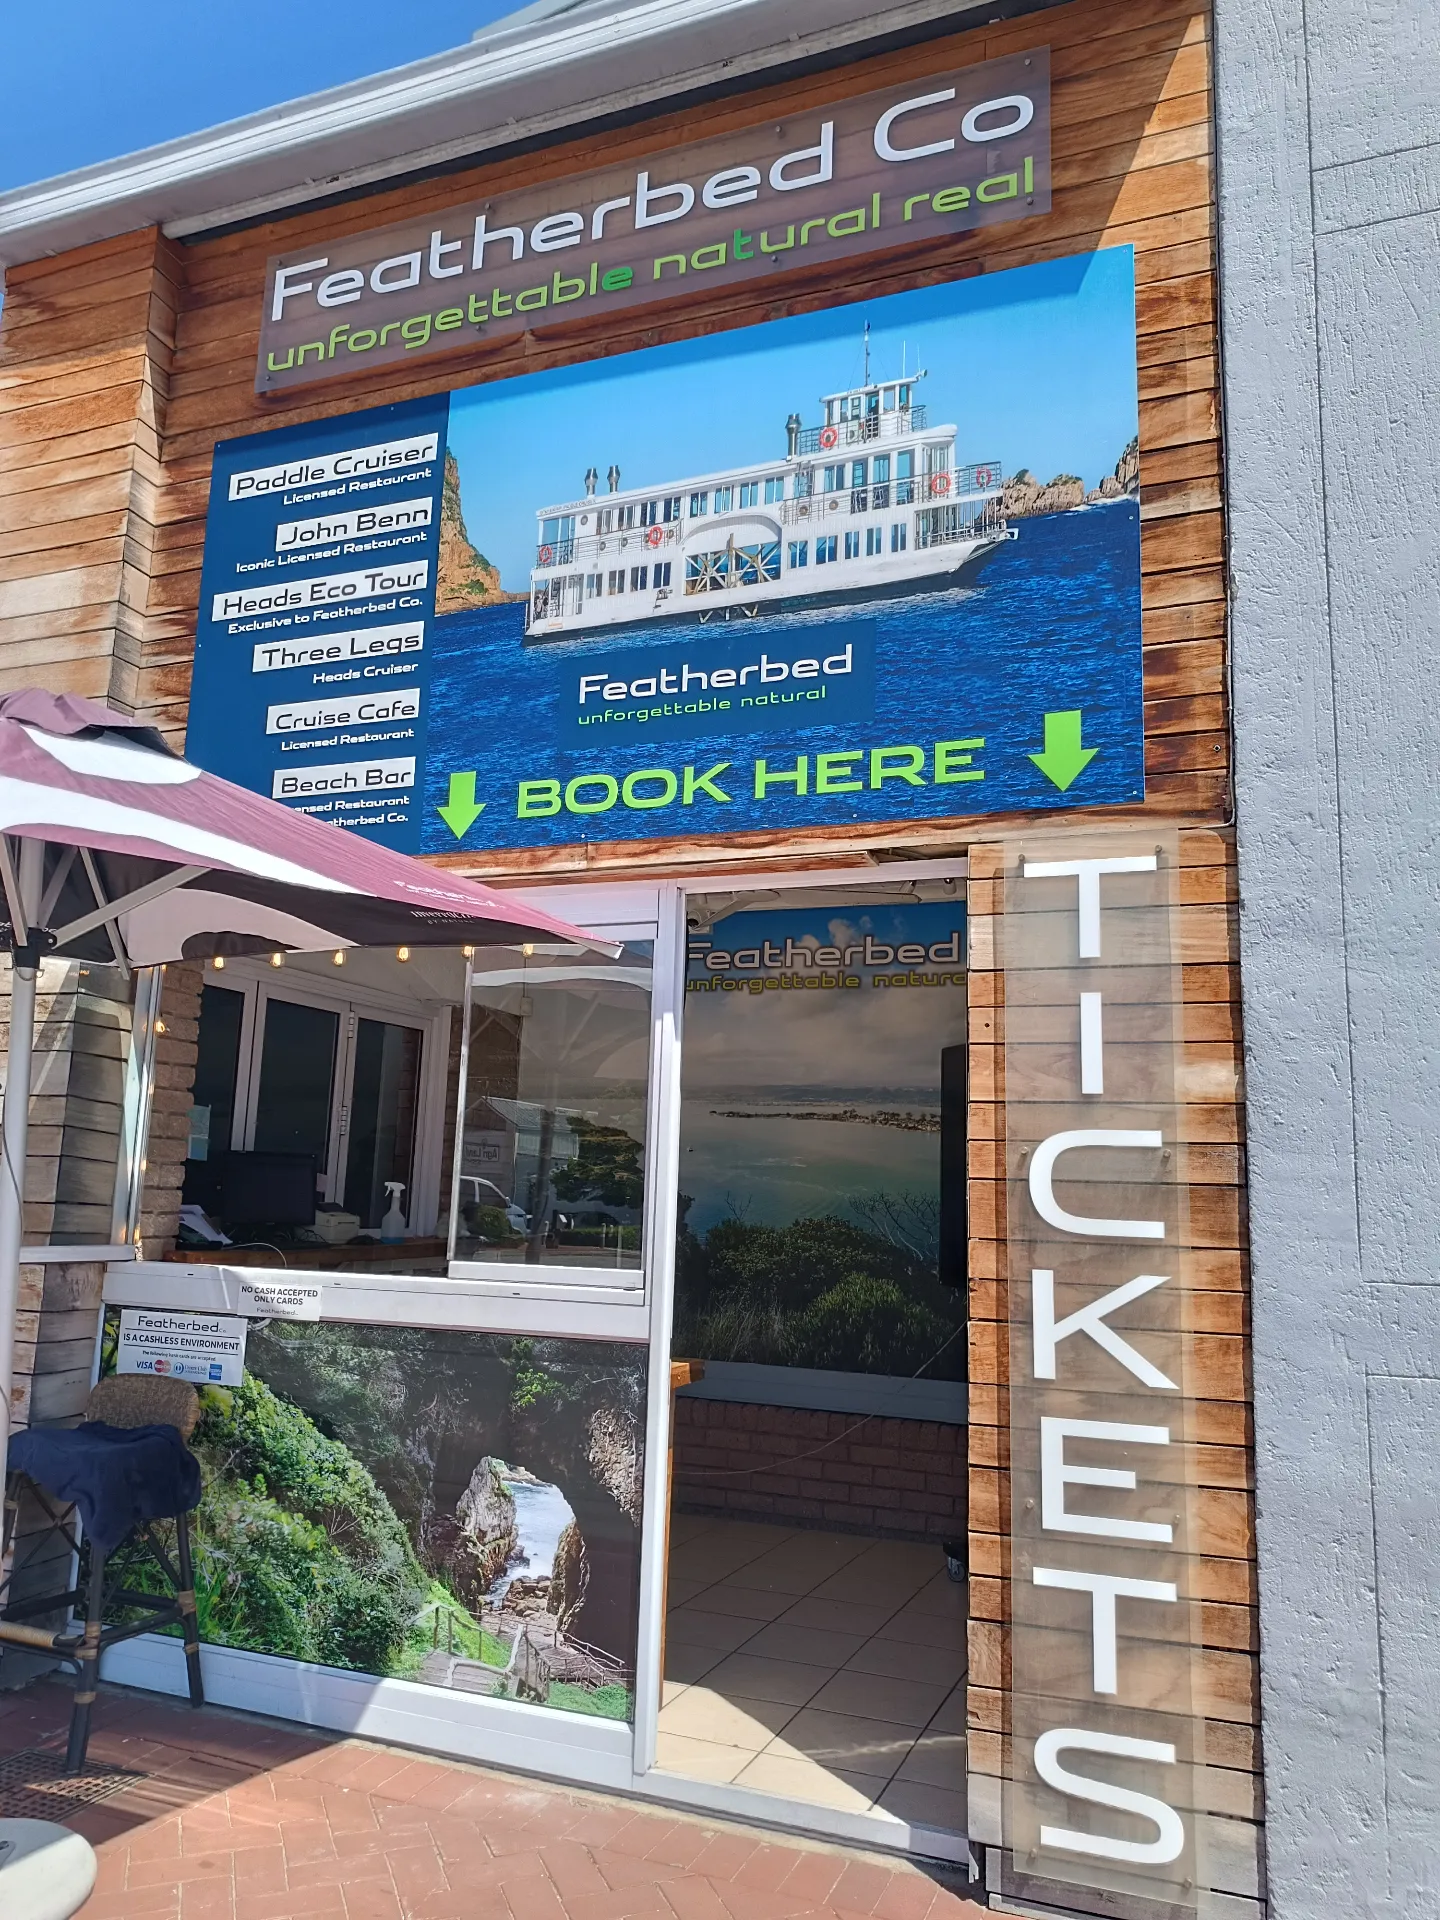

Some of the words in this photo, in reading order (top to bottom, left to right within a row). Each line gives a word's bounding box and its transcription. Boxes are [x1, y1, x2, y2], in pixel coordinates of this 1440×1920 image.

[271, 121, 834, 321] Featherbed
[873, 87, 1034, 162] Co
[267, 261, 633, 371] unforgettable
[653, 192, 880, 280] natural
[904, 157, 1034, 221] real
[236, 466, 325, 495] Paddle
[333, 445, 433, 475] Cruiser
[283, 484, 345, 505] Licensed
[349, 468, 432, 492] Restaurant
[281, 523, 348, 546] John
[357, 509, 428, 532] Benn
[236, 559, 275, 573] Iconic
[278, 547, 340, 566] Licensed
[344, 532, 427, 554] Restaurant
[223, 589, 302, 616] Heads
[310, 582, 357, 601] Eco
[365, 572, 424, 592] Tour
[228, 617, 291, 634] Exclusive
[294, 614, 310, 624] to
[313, 599, 396, 621] Featherbed
[399, 596, 423, 608] Co.
[262, 646, 341, 667] Three
[350, 634, 420, 655] Legs
[313, 670, 360, 683] Heads
[363, 664, 418, 677] Cruiser
[578, 644, 852, 704] Featherbed
[276, 711, 351, 730] Cruise
[358, 701, 416, 721] Cafe
[578, 697, 731, 725] unforgettable
[741, 685, 827, 707] natural
[281, 736, 338, 750] Licensed
[340, 729, 415, 744] Restaurant
[282, 774, 357, 794] Beach
[365, 768, 411, 786] Bar
[517, 763, 732, 819] BOOK
[754, 738, 985, 800] HERE
[335, 796, 410, 811] Restaurant
[387, 812, 409, 823] Co.
[874, 971, 967, 986] natura
[241, 1285, 254, 1293] NO
[254, 1287, 276, 1296] CASH
[277, 1288, 318, 1297] ACCEPTED
[254, 1295, 275, 1304] ONLY
[276, 1297, 303, 1306] CARDS
[137, 1316, 219, 1333] Featherbed
[123, 1333, 131, 1341] IS
[132, 1334, 138, 1342] A
[139, 1335, 179, 1345] CASHLESS
[180, 1338, 240, 1350] ENVIRONMENT
[136, 1360, 153, 1370] VISA
[1022, 855, 1186, 1866] TICKETS
